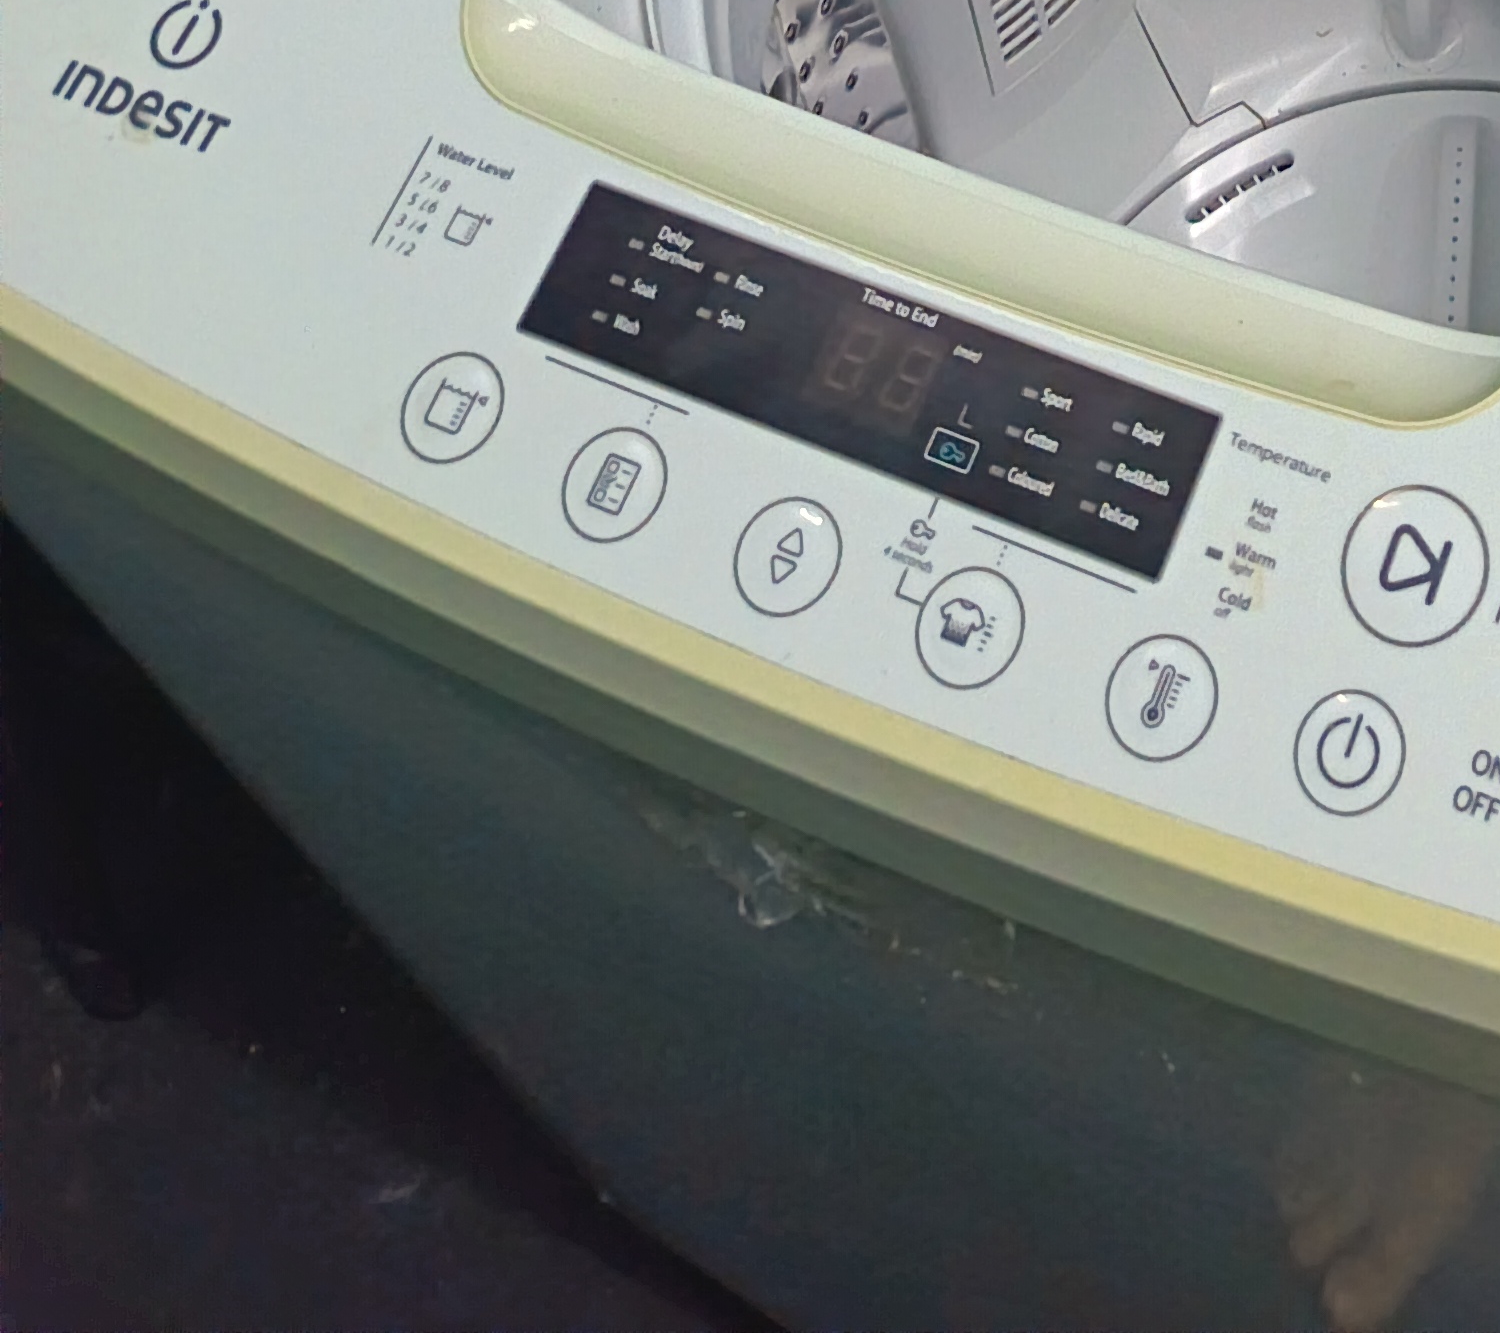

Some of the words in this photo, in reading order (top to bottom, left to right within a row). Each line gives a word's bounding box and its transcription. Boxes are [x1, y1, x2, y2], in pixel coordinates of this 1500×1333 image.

[437, 141, 475, 169] Water
[477, 156, 515, 181] Level
[861, 286, 894, 314] Time
[895, 302, 910, 319] to
[911, 306, 940, 329] End
[1229, 431, 1332, 483] Temperature
[1251, 498, 1279, 520] Hot
[1235, 541, 1278, 570] Warm
[1218, 586, 1253, 612] Cold
